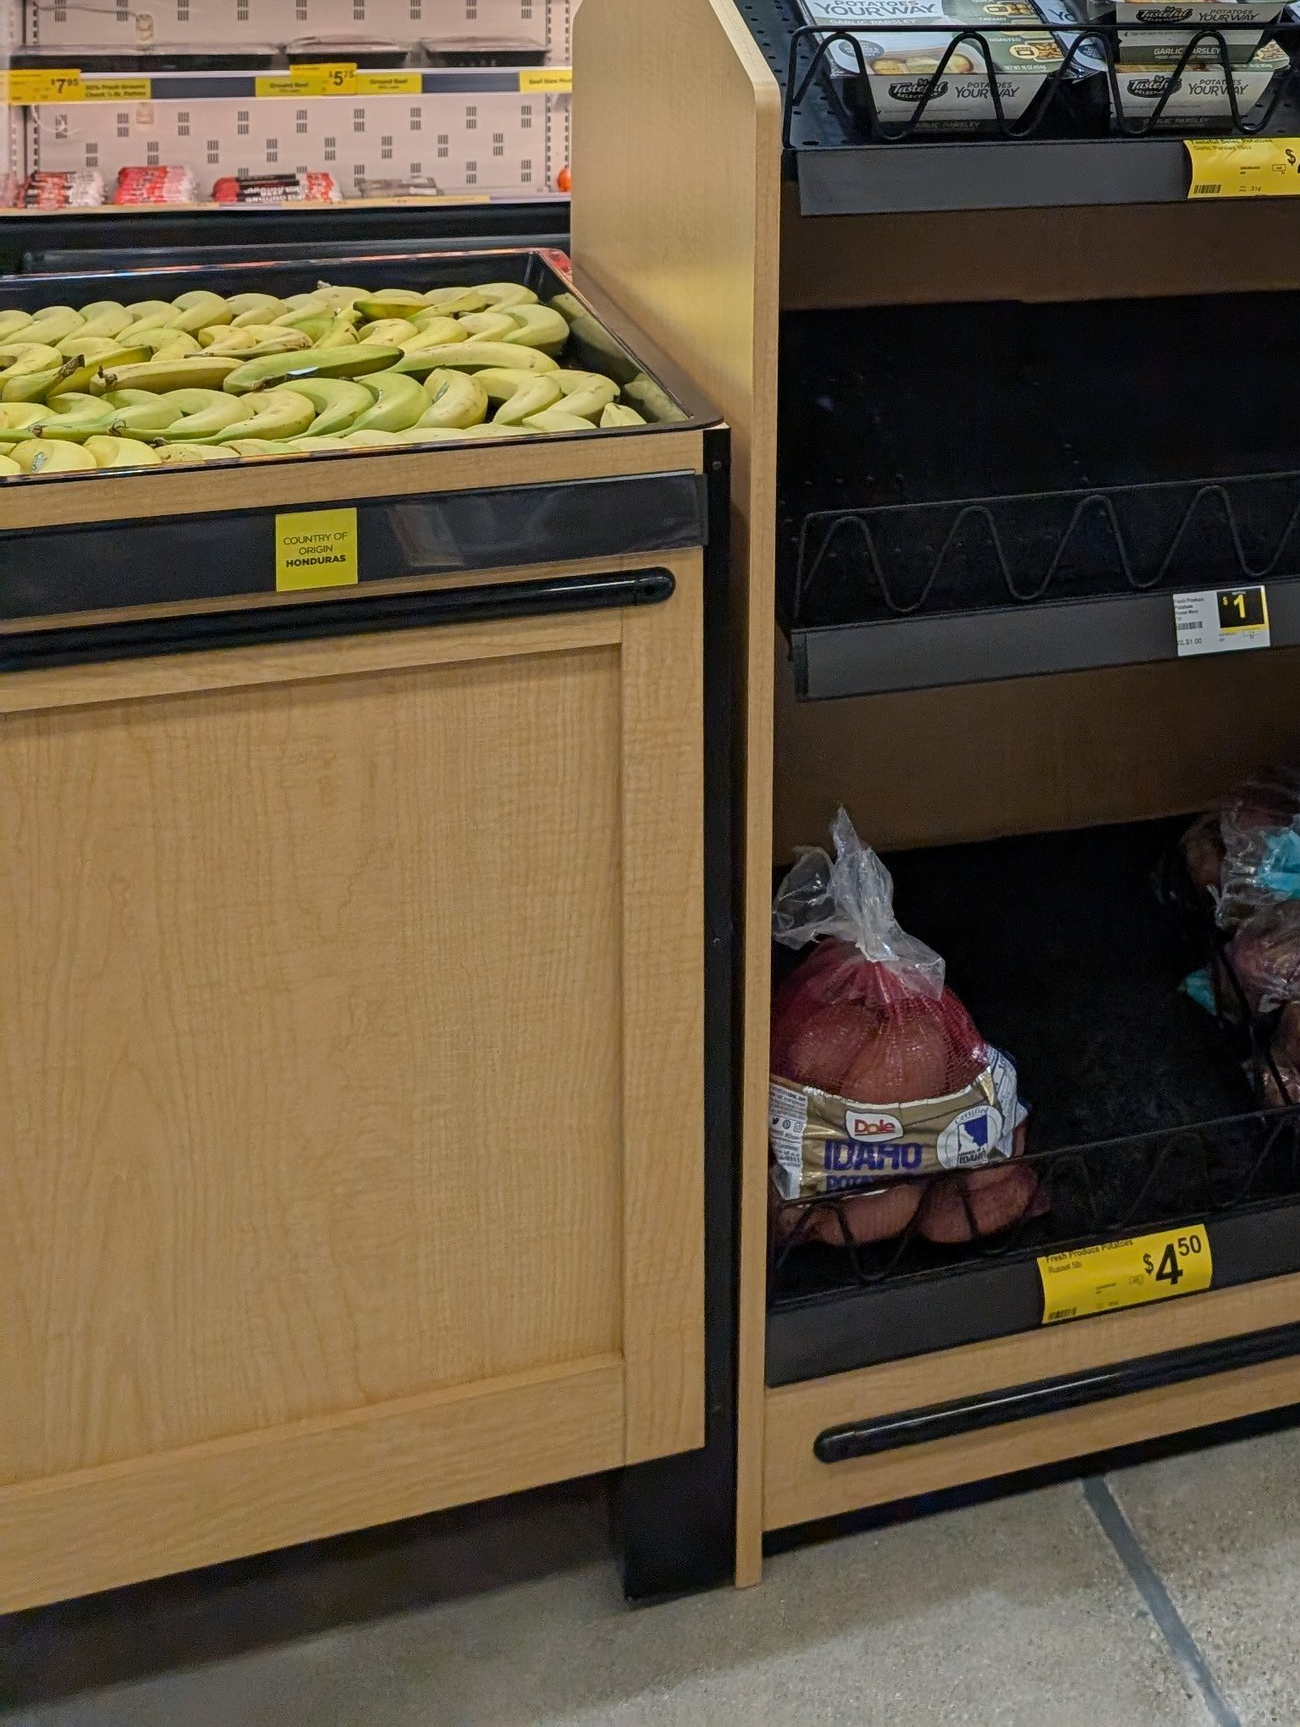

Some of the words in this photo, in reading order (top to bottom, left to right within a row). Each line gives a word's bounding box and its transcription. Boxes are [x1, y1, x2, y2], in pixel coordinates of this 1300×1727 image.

[1140, 9, 1191, 17] Tasteful
[283, 534, 331, 545] COUNTRY
[334, 532, 348, 540] OF
[299, 545, 333, 555] ORIGIN
[286, 555, 346, 567] HONDURAS
[854, 1119, 896, 1137] Dole
[824, 1139, 923, 1171] IDAHO
[1046, 1252, 1067, 1263] Fresh
[1068, 1247, 1100, 1258] Produce
[1101, 1240, 1133, 1250] Potatoes
